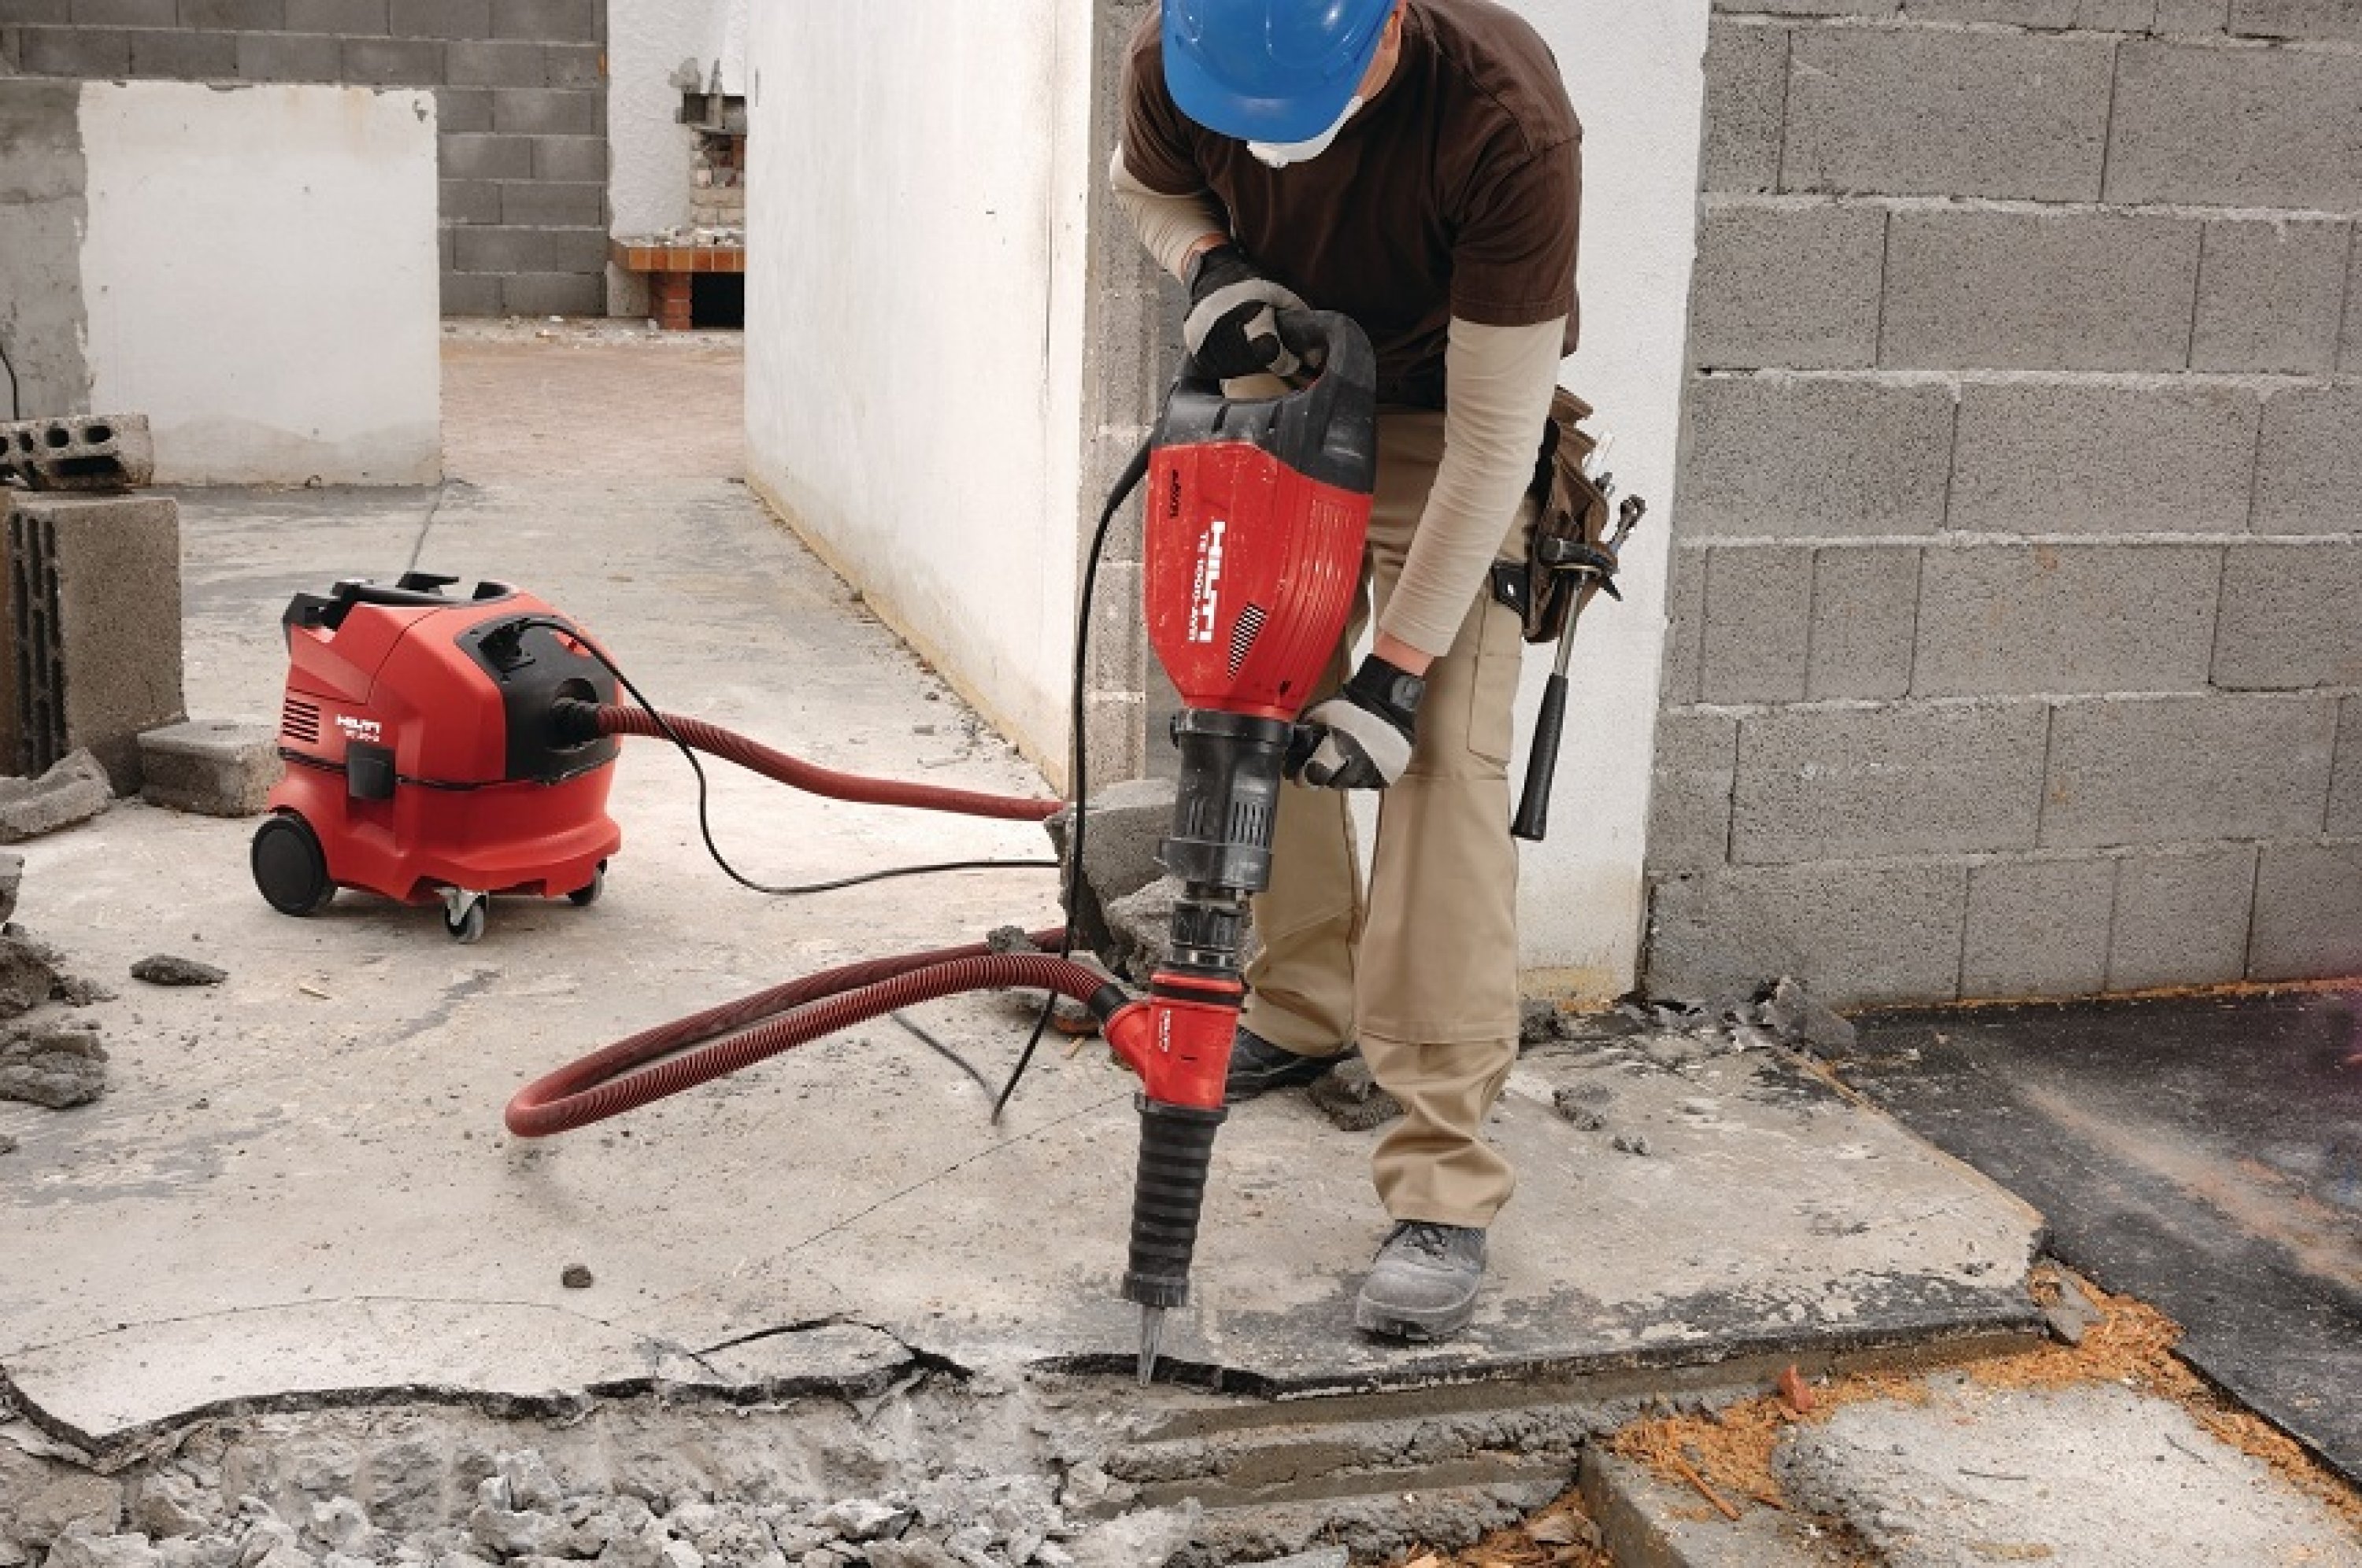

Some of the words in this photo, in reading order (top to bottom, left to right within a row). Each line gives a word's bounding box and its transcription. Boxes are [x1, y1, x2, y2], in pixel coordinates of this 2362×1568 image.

[1197, 531, 1209, 553] TE
[1199, 521, 1225, 642] HILTI
[335, 713, 383, 734] HILTI
